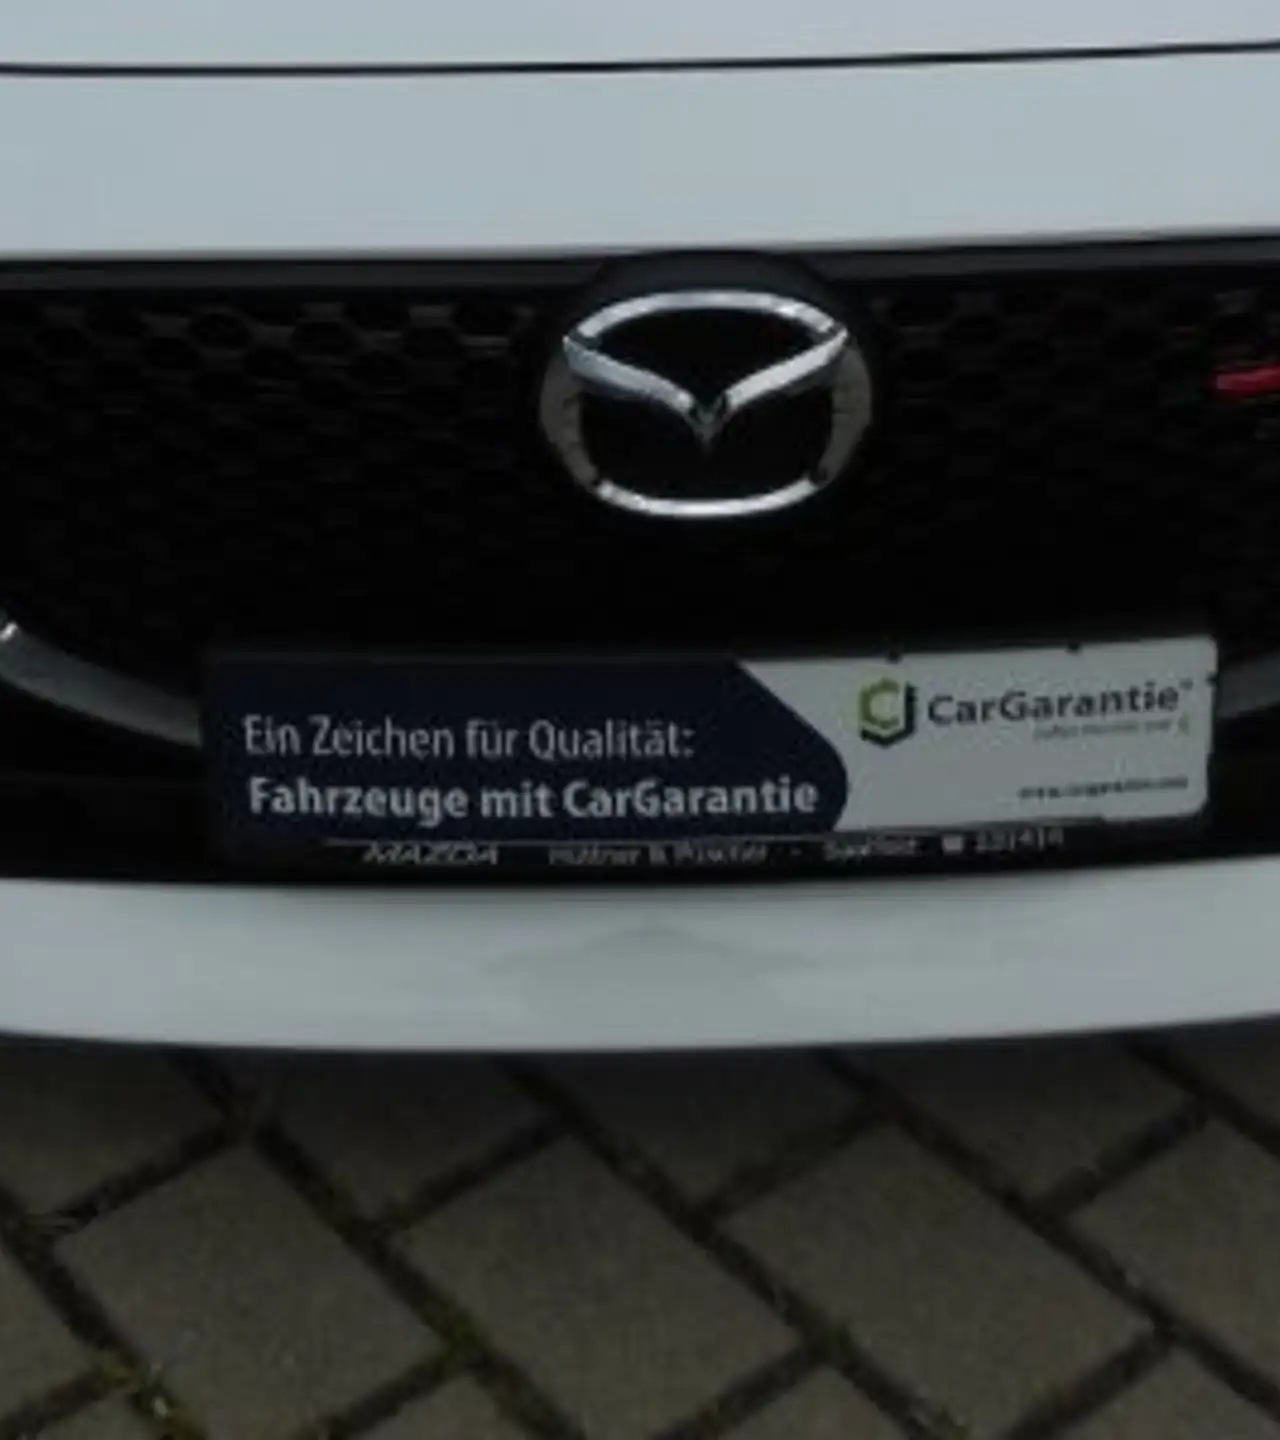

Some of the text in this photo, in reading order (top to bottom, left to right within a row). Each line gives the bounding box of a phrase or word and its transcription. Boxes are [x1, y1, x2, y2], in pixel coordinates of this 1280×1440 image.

[927, 679, 1179, 727] CarGarantie
[242, 714, 696, 762] Ein Zeichen für Qualität:
[249, 773, 820, 829] Fahrzeuge mit CarGarantie
